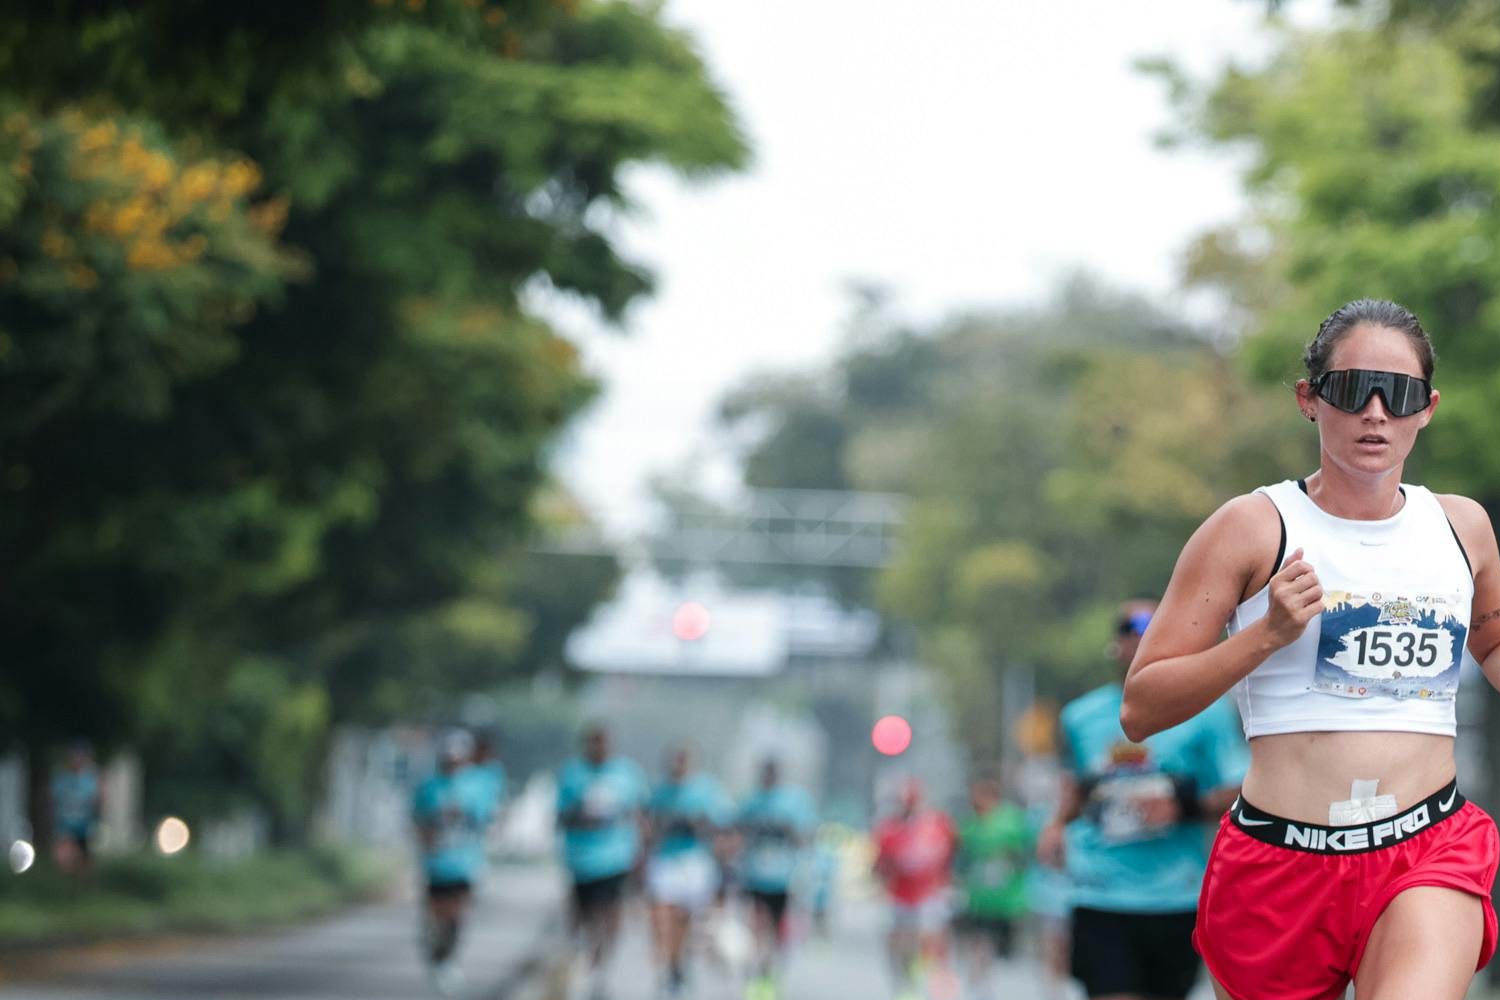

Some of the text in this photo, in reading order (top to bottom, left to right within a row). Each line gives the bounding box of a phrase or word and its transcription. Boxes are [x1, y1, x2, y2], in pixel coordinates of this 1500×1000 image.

[1354, 630, 1438, 667] 1535
[1284, 804, 1431, 850] NIKE PRO
